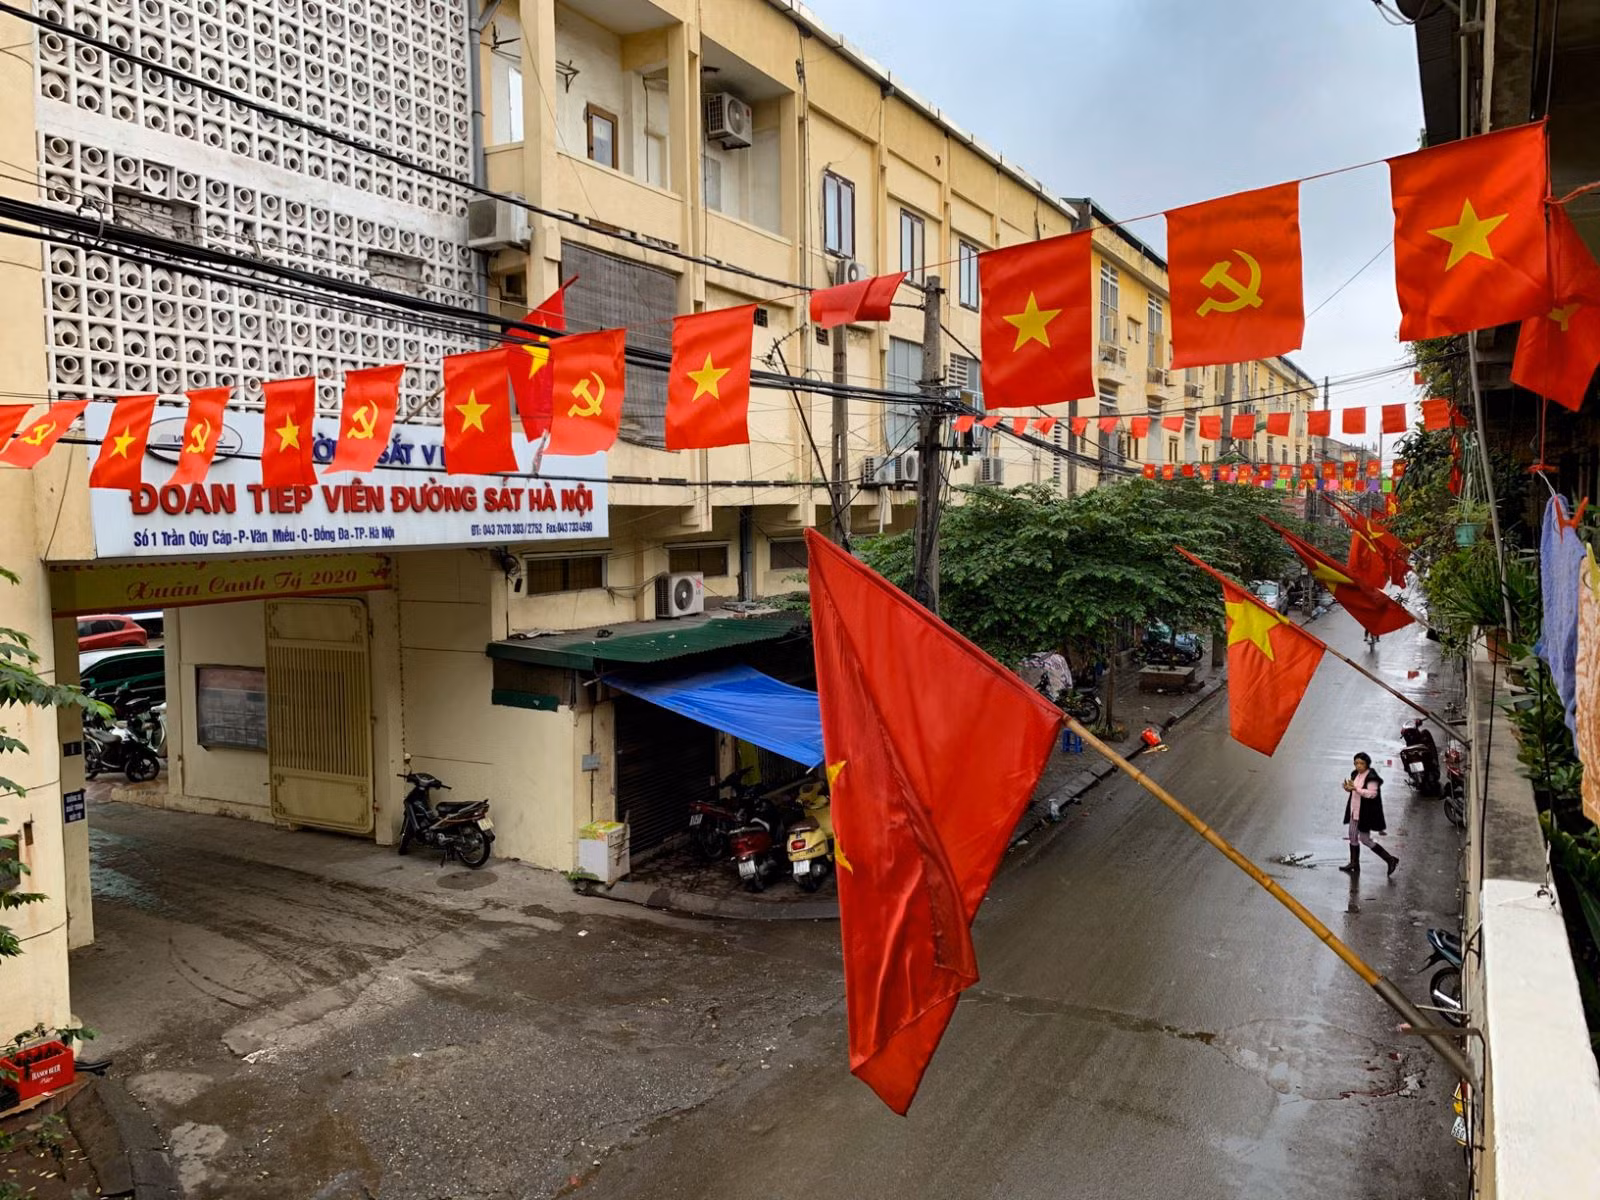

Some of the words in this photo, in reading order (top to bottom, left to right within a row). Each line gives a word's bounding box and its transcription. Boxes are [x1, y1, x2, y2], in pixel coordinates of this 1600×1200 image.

[321, 477, 385, 513] VIÊN
[390, 476, 477, 513] ĐƯỜNG
[528, 481, 557, 512] HÀ
[561, 482, 593, 517] NỘI
[134, 528, 149, 547] Số
[151, 531, 157, 547] 1
[161, 528, 185, 546] Trần
[382, 525, 395, 541] Nội
[126, 580, 200, 601] Xuân
[208, 575, 266, 593] Canh
[310, 569, 357, 586] 2020
